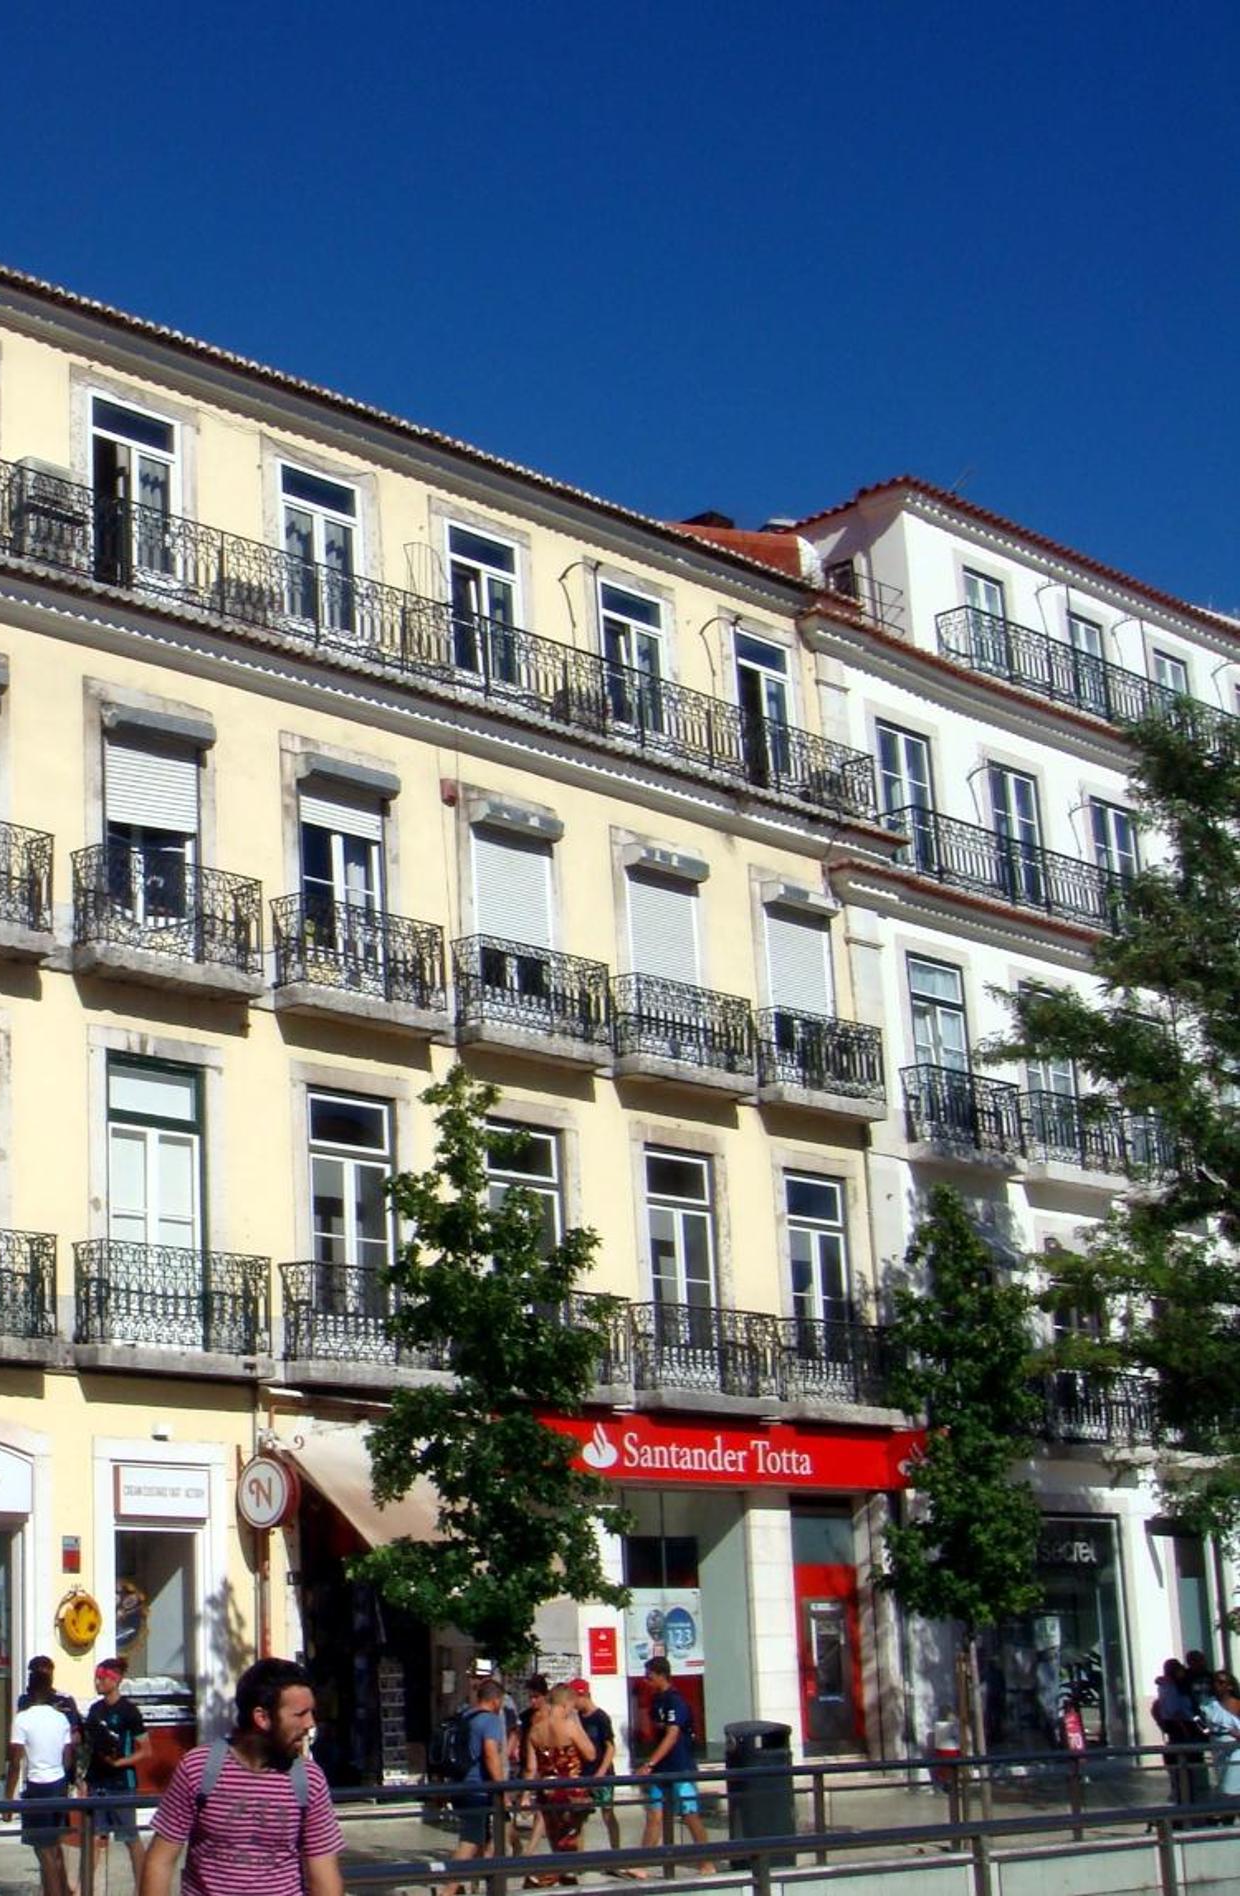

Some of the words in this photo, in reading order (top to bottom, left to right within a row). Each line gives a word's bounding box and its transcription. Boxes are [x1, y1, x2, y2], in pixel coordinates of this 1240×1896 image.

[623, 1432, 746, 1472] Santander
[750, 1440, 813, 1475] Totta
[248, 1476, 272, 1509] N
